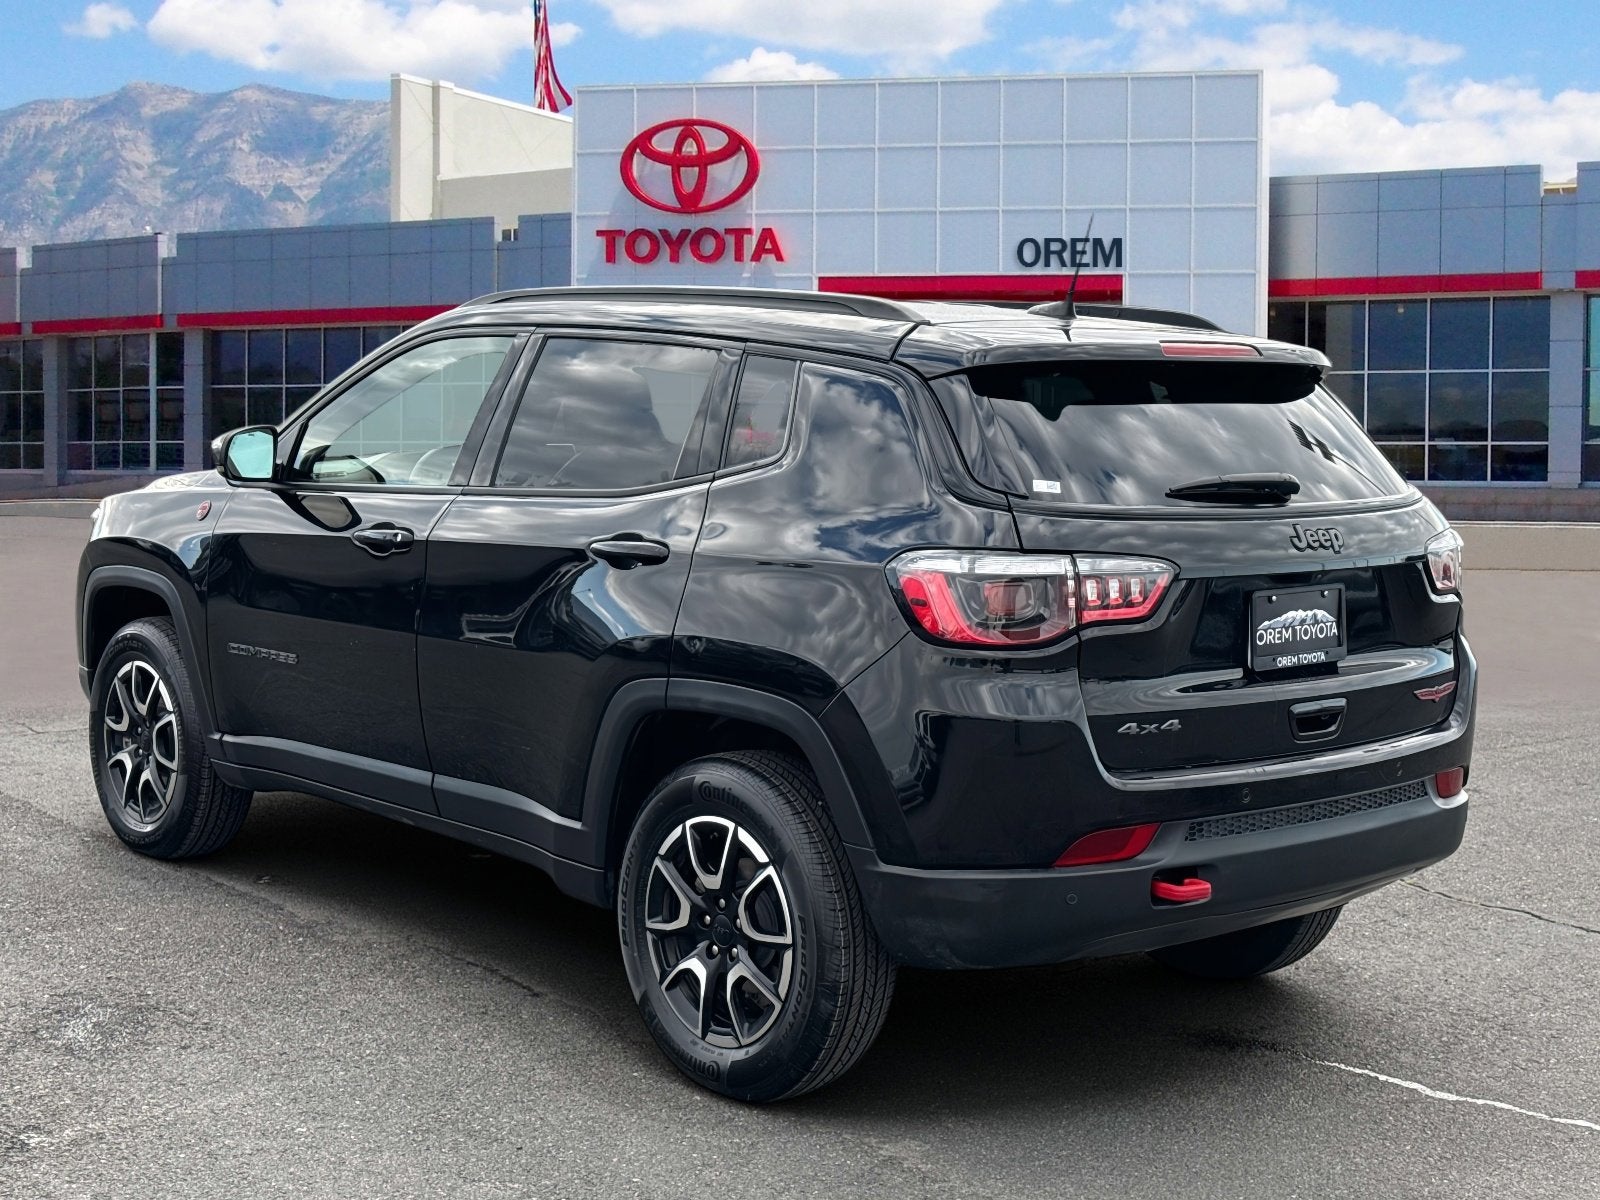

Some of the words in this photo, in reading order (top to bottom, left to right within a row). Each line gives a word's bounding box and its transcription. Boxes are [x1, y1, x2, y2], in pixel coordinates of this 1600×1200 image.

[596, 228, 785, 263] TOYOTA
[1016, 237, 1123, 268] OREM
[1290, 524, 1345, 554] Jeep
[1256, 627, 1292, 646] OREM
[1295, 622, 1338, 640] TOYOTA
[1277, 655, 1298, 667] OREM
[1299, 652, 1325, 664] TOYOTA
[1117, 719, 1182, 735] 4x4
